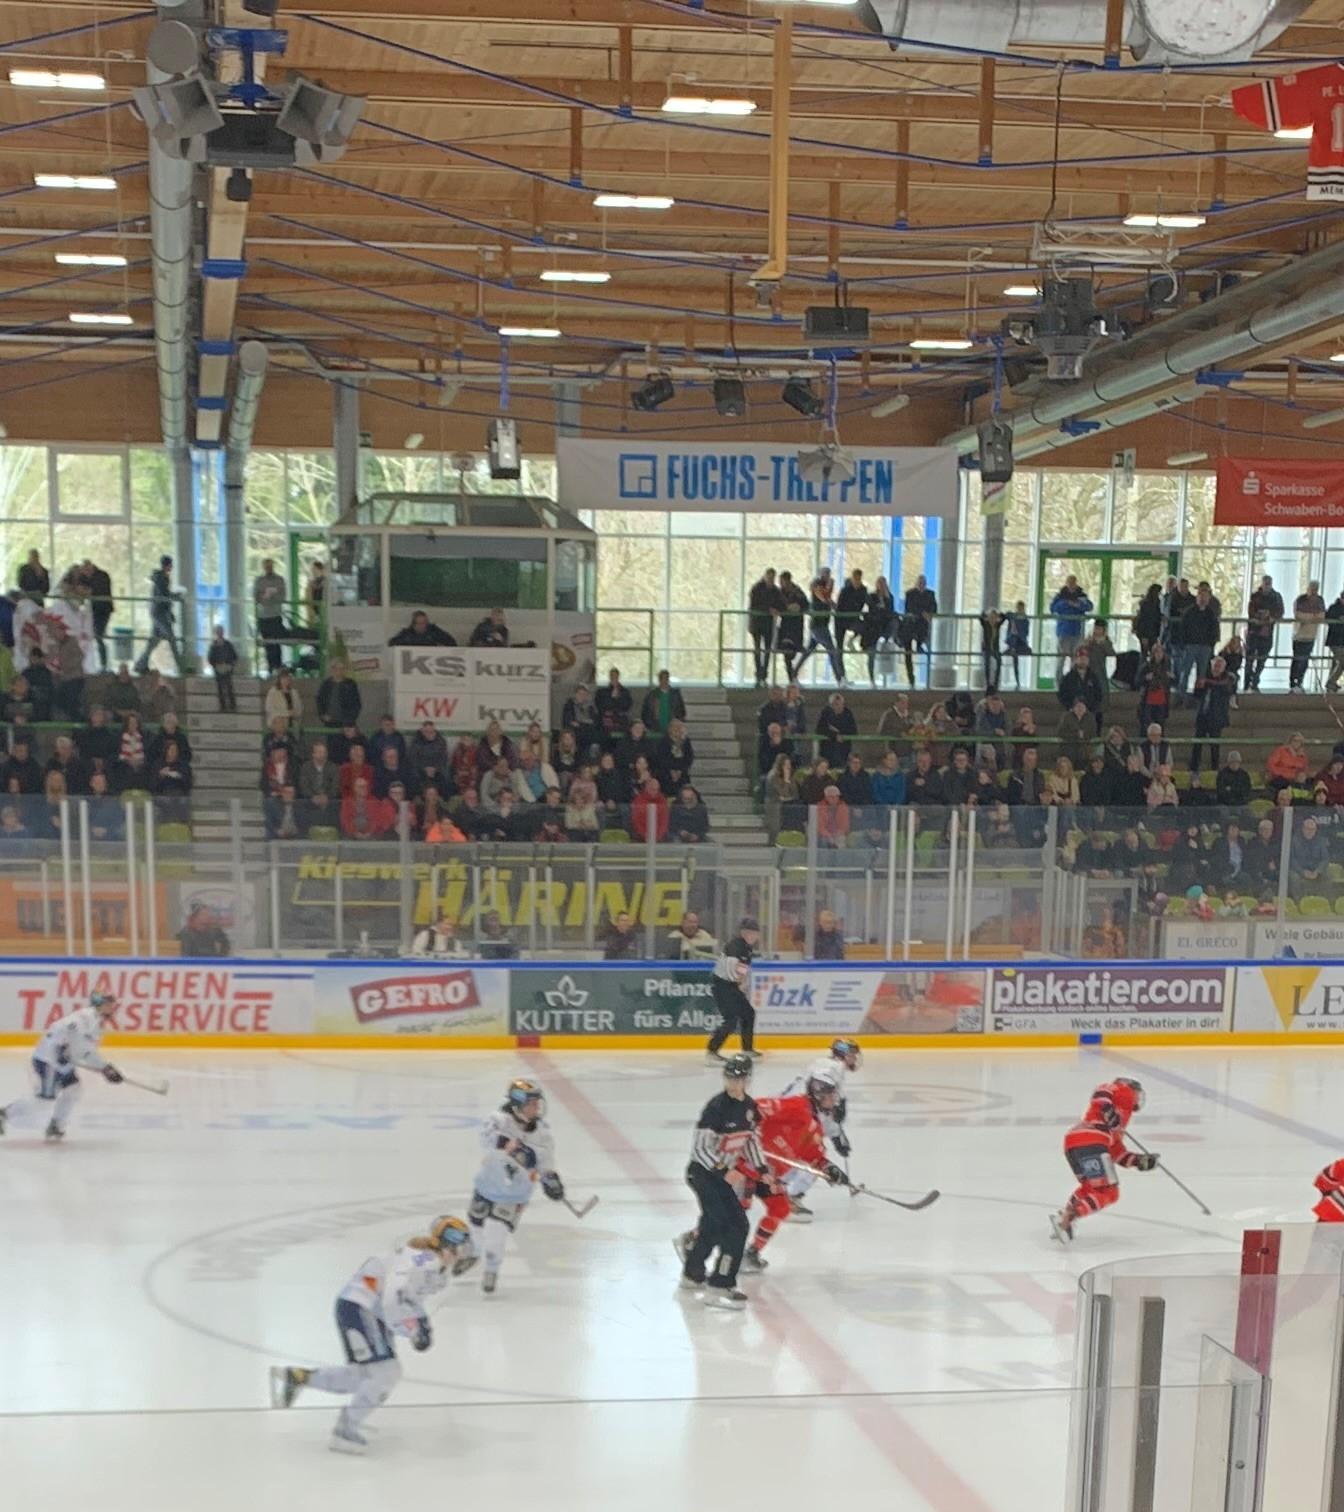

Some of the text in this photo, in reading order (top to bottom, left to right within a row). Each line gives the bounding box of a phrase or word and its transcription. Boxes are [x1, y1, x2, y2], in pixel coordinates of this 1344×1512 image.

[1264, 482, 1325, 498] Sparkasse
[413, 697, 459, 718] KW
[412, 869, 691, 927] HÄRING
[57, 970, 229, 1000] MAICHEN
[357, 980, 469, 1014] GEFRO
[766, 983, 817, 1007] bzk
[993, 971, 1223, 1011] plakatier.com
[18, 990, 274, 1033] TAKSERVICE
[515, 1010, 616, 1031] KUTTER
[633, 1008, 673, 1028] fürs
[1070, 1017, 1220, 1029] Weck das Plakatier in dir!
